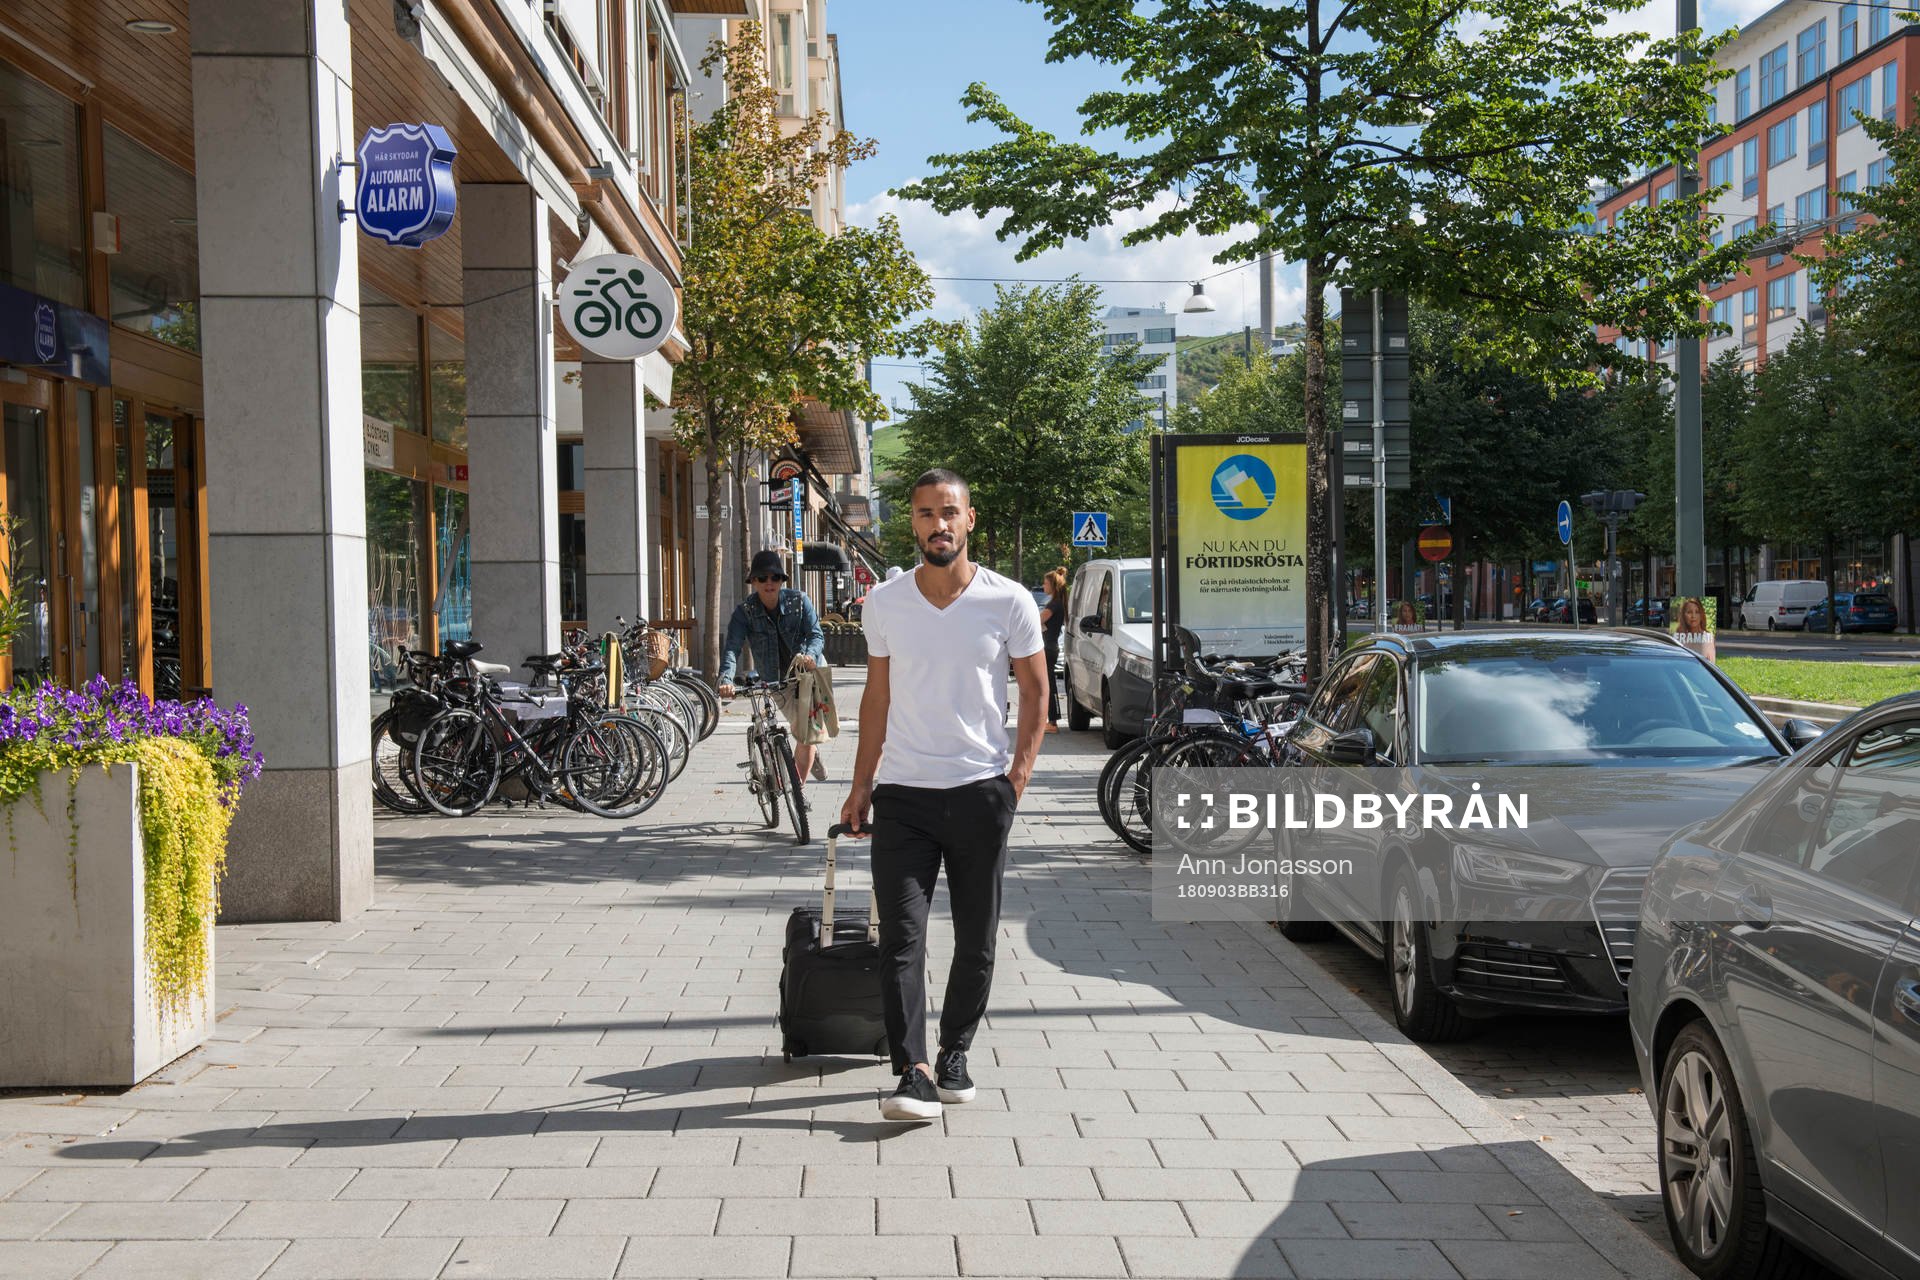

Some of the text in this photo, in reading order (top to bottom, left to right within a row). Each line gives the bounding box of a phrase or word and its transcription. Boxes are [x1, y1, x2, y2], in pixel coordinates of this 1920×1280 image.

[375, 151, 419, 160] HÄR SKYDDAR
[370, 168, 422, 185] AUTOMATIC
[367, 186, 424, 213] ALARM
[367, 423, 389, 443] SJÖSTADEN
[367, 441, 381, 457] CYKEL
[1203, 539, 1286, 552] NU KAN DU
[1186, 552, 1304, 569] FÖRTIDSRÖSTA
[1219, 578, 1227, 587] på
